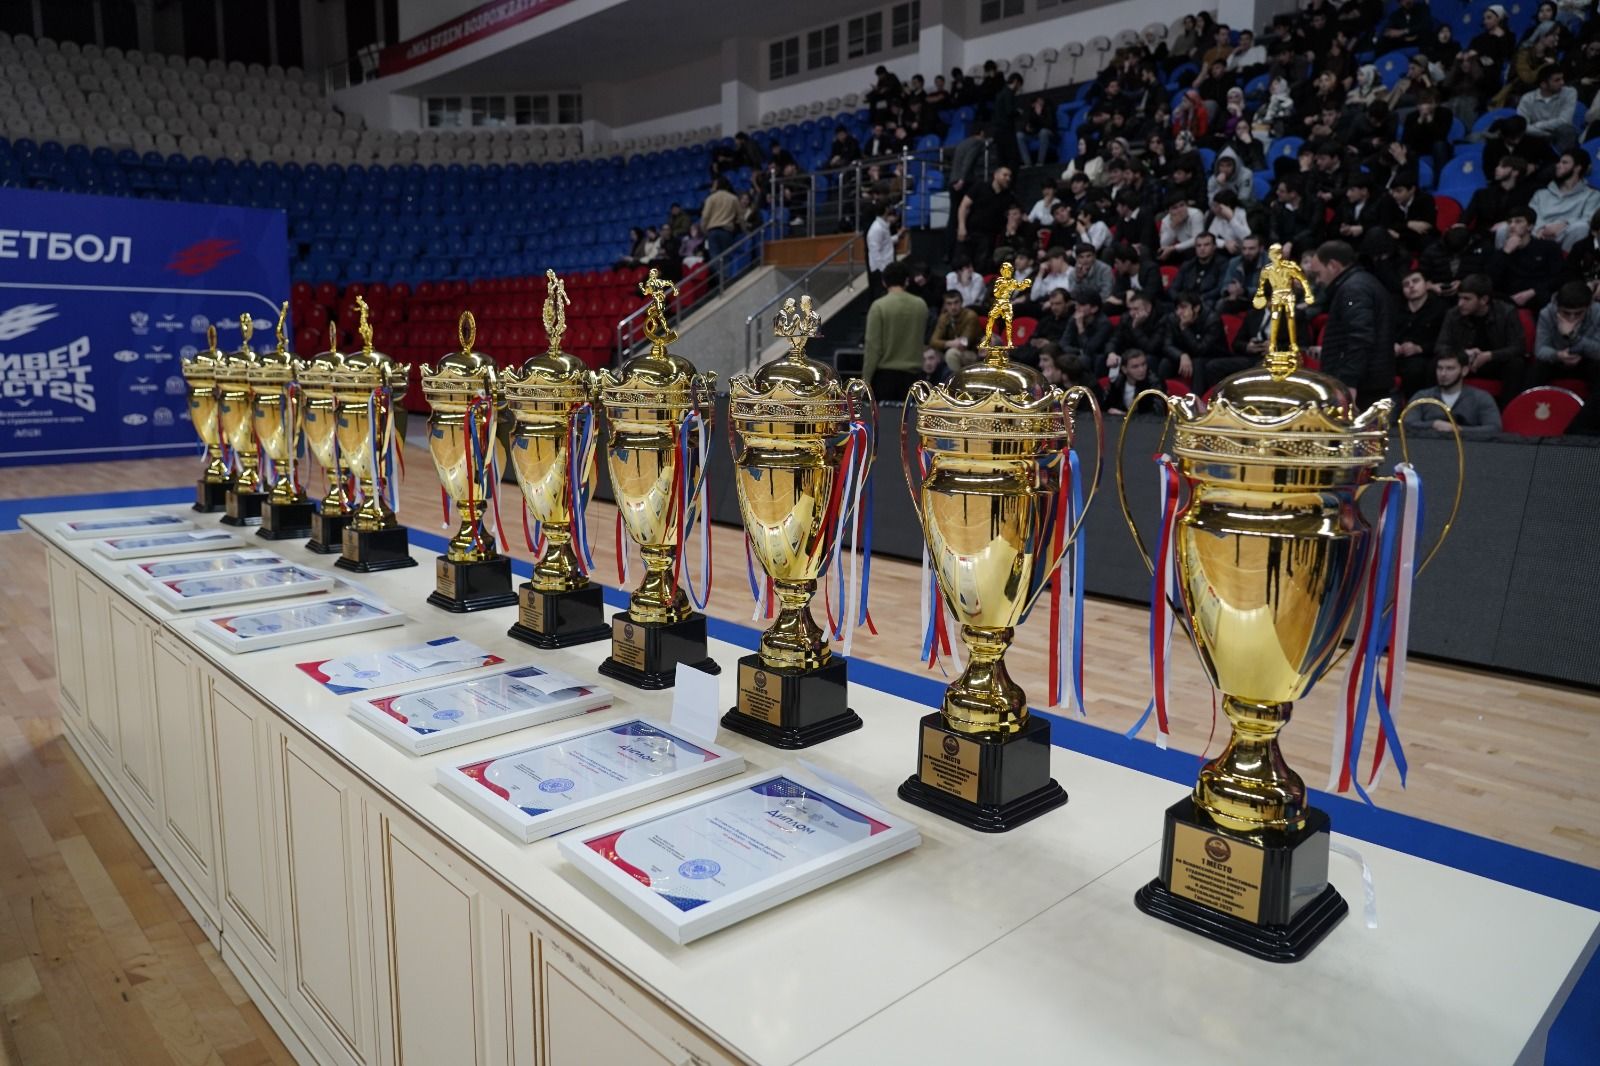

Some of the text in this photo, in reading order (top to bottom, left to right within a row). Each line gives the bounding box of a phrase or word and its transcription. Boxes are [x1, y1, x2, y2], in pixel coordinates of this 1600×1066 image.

[0, 229, 132, 264] ЕТБОЛ
[0, 380, 96, 412] СТ25
[1206, 860, 1233, 874] МЕСТО
